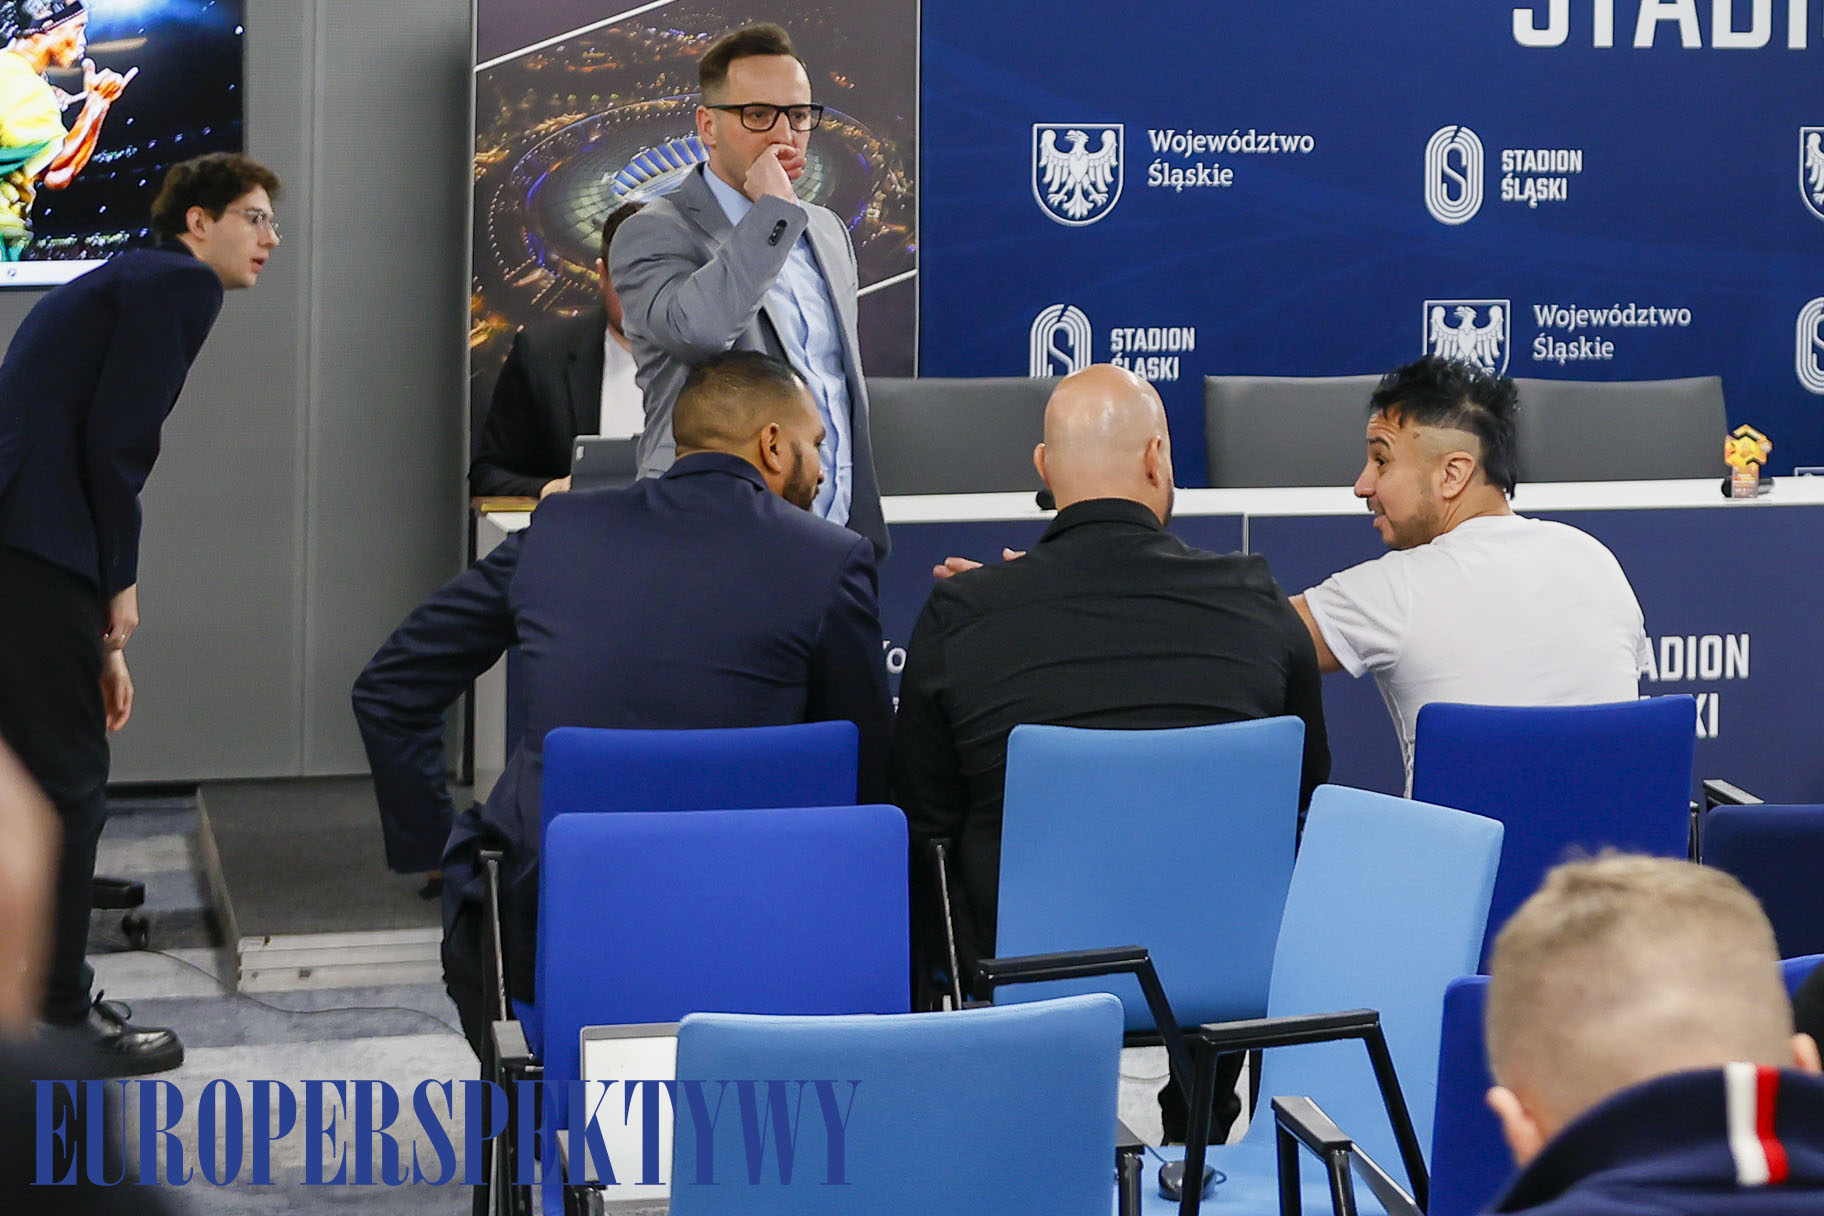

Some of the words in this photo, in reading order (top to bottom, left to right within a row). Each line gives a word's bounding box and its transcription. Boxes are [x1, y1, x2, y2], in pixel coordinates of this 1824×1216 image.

[1147, 127, 1315, 158] Województwo
[1147, 158, 1234, 191] Śląskie
[1501, 149, 1583, 175] STADION
[1501, 171, 1567, 208] ŚLĄSKI
[1532, 302, 1692, 331] Województwo
[1111, 327, 1196, 353] STADION
[1532, 331, 1616, 364] Śląskie
[1640, 633, 1750, 681] ADION
